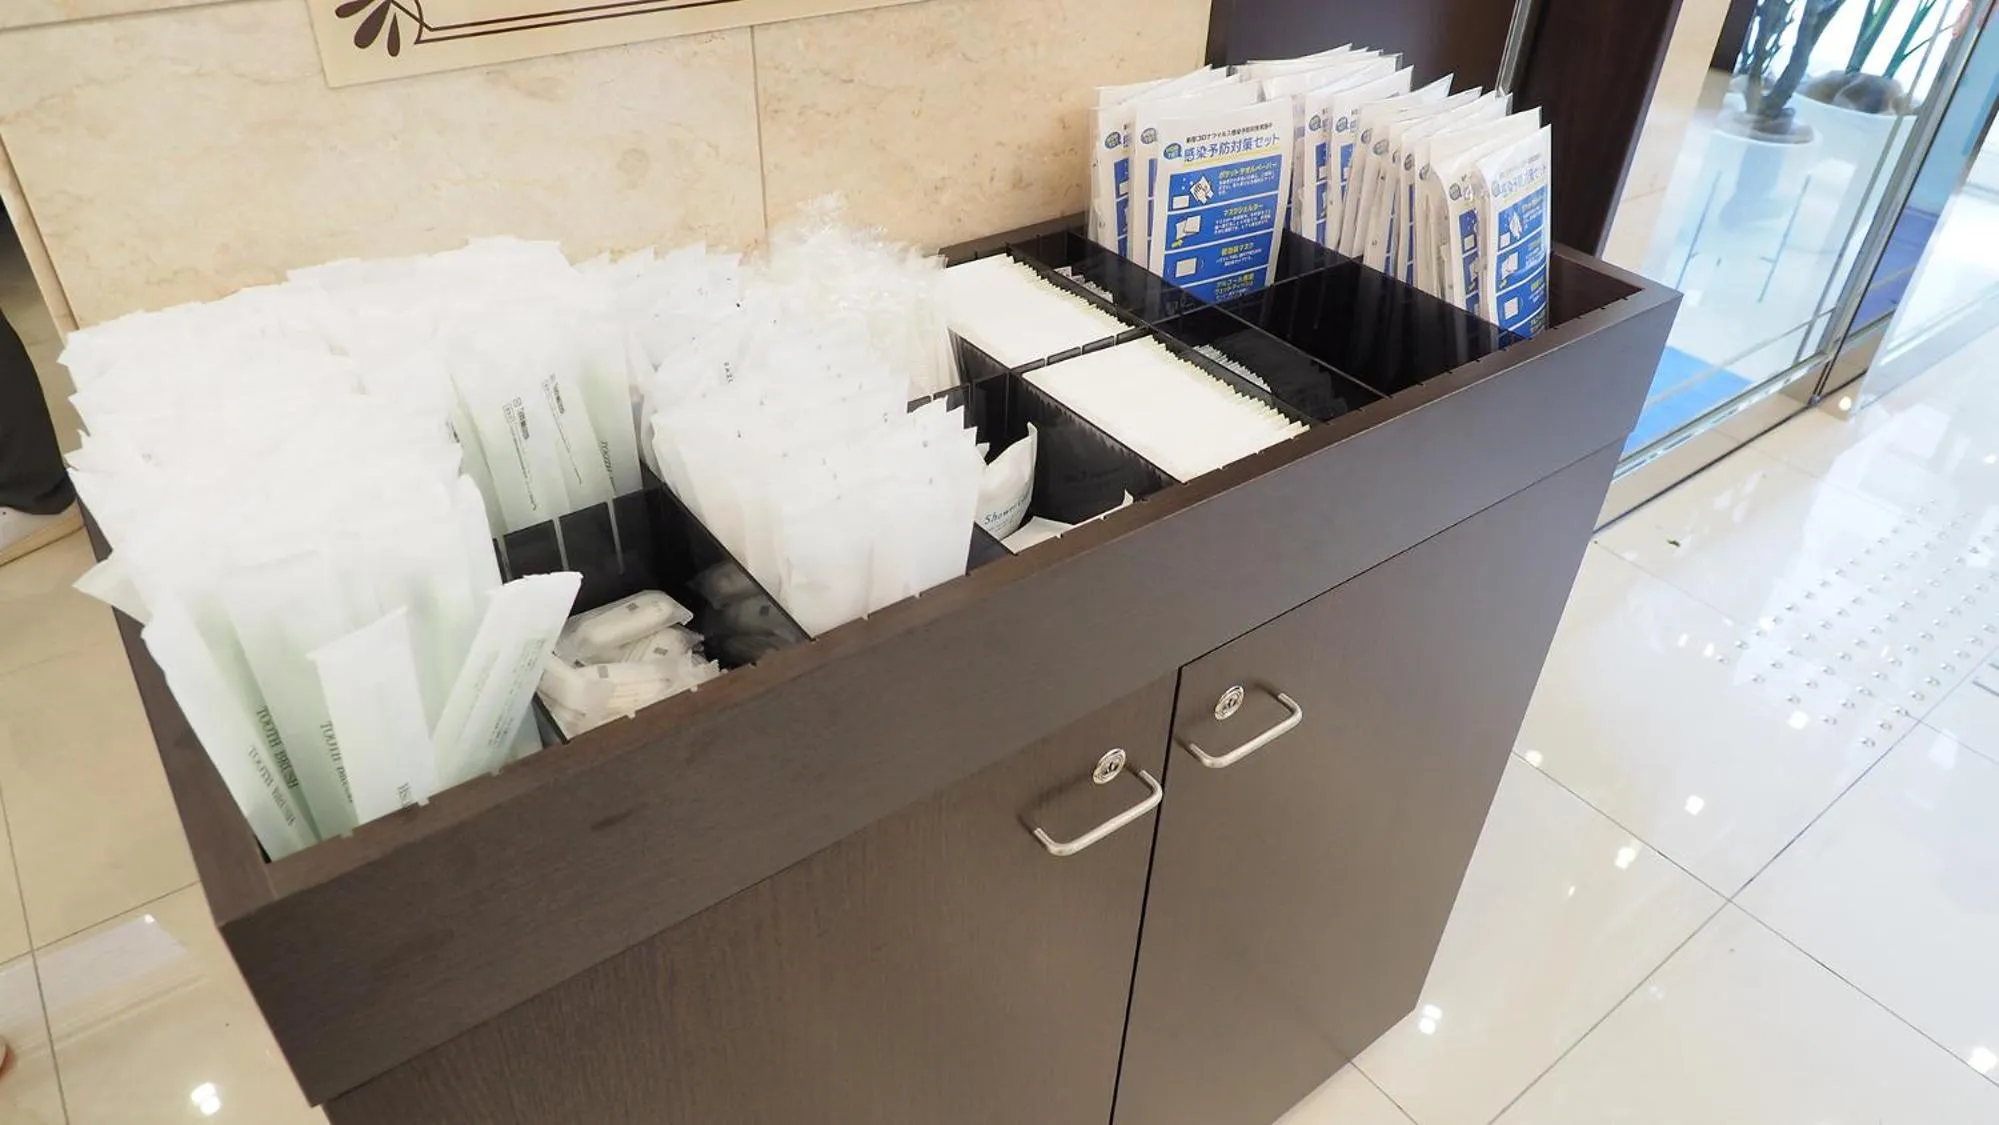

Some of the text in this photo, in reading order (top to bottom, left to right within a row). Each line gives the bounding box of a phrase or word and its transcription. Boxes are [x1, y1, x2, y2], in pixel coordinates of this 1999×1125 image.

[1184, 133, 1280, 162] 感染予防対策セット
[256, 705, 299, 789] TOOTH BRUSH
